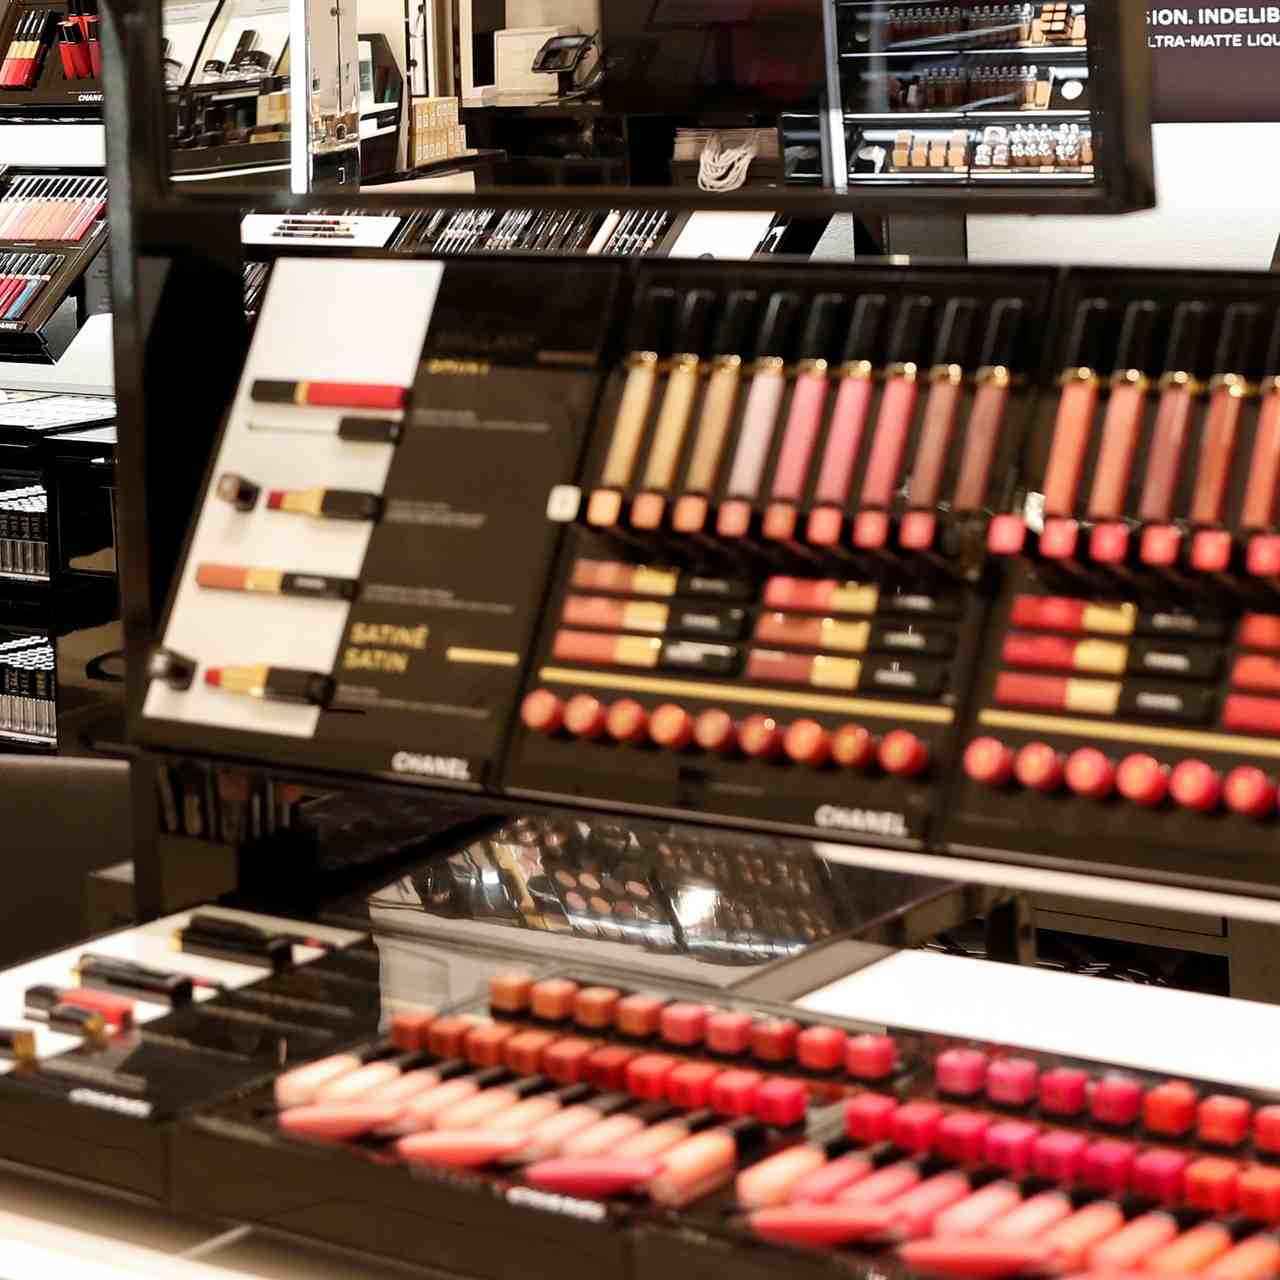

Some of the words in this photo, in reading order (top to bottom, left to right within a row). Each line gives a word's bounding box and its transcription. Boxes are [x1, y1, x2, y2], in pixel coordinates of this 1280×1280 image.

[78, 94, 105, 102] CHANE
[391, 751, 471, 781] CHANEL
[814, 804, 908, 837] CHANEL
